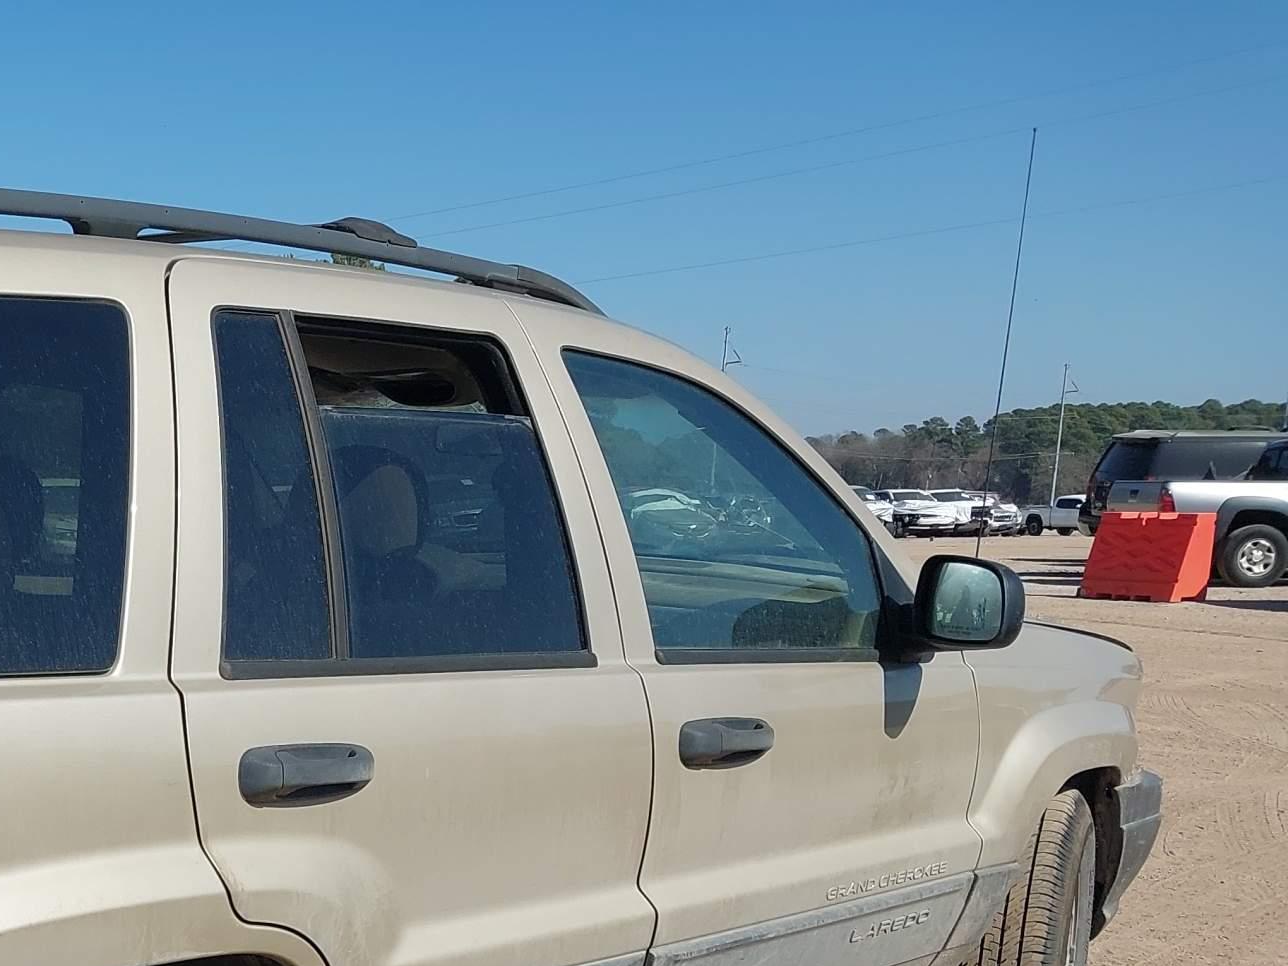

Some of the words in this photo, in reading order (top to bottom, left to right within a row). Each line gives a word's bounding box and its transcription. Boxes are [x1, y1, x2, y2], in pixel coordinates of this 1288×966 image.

[825, 879, 876, 901] GRAND
[878, 861, 949, 889] CHEROKEE
[848, 909, 931, 944] LAREDO
